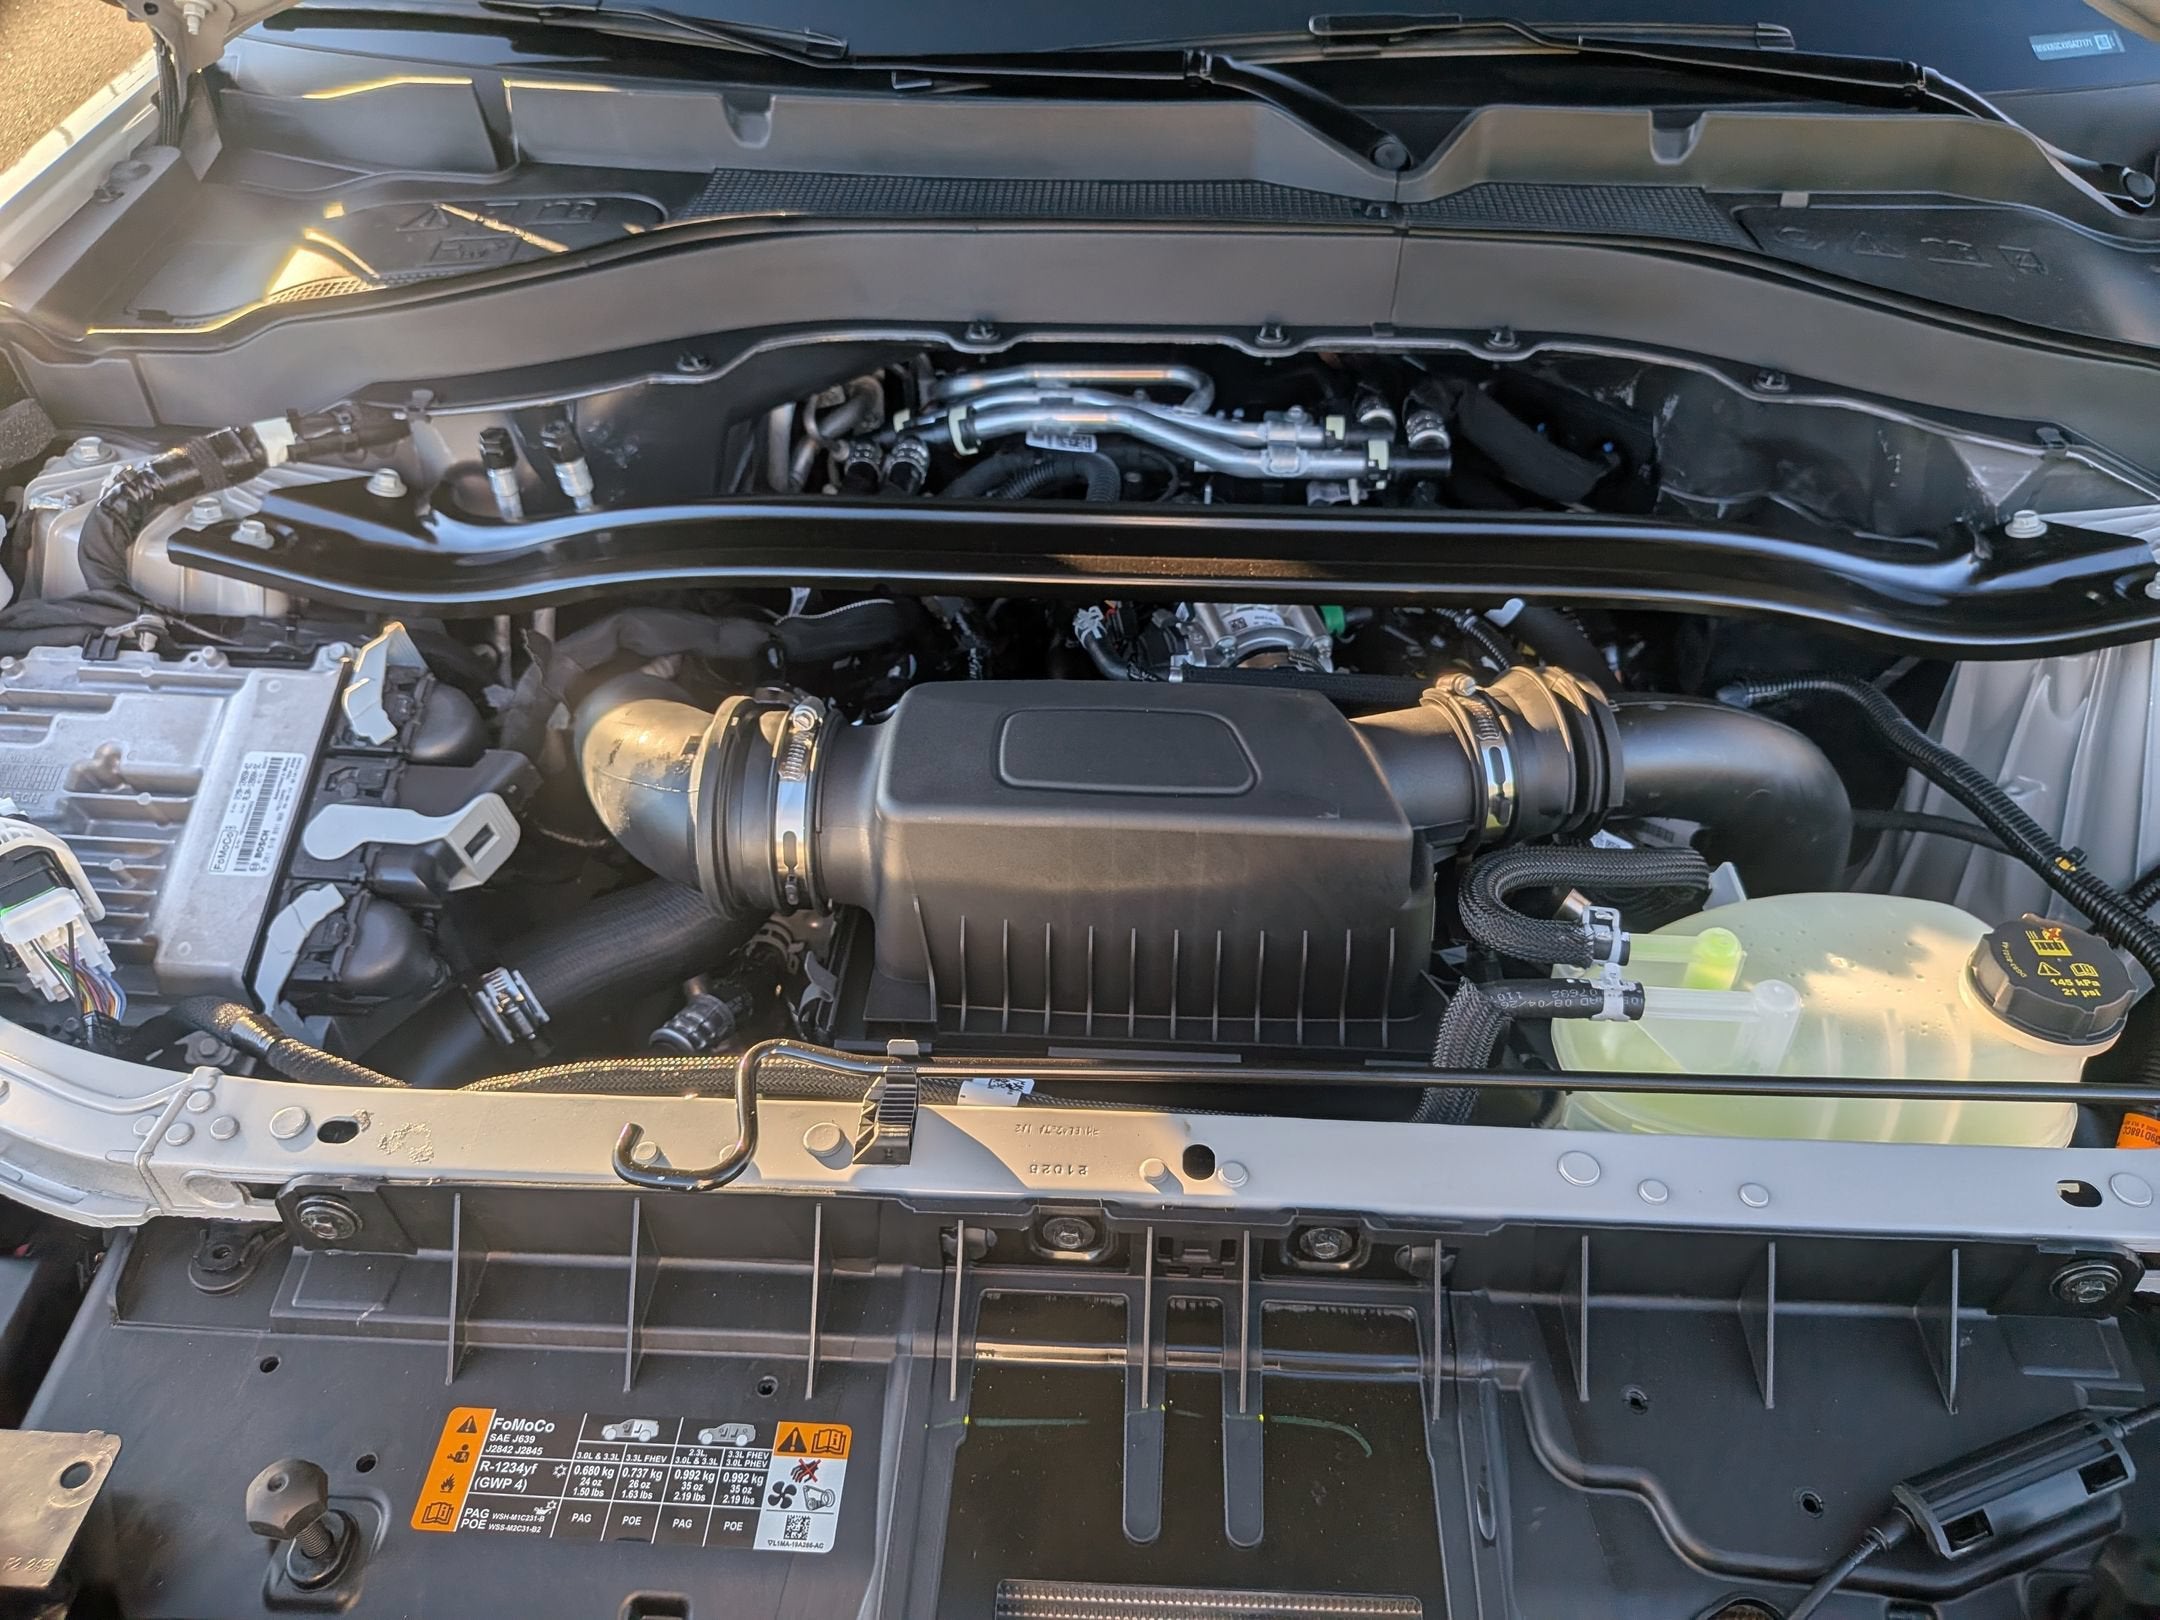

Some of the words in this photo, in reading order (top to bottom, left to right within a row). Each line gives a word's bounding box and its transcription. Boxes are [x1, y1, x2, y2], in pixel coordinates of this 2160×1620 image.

[254, 829, 270, 859] BOSCH
[213, 830, 234, 870] FoMoCo
[2050, 978, 2072, 987] 145
[2075, 978, 2101, 987] kPa
[2061, 987, 2078, 996] 21
[2080, 988, 2101, 998] psi
[492, 1417, 556, 1433] FoMoCo
[489, 1433, 511, 1443] SAE
[512, 1434, 536, 1445] J639
[485, 1444, 514, 1454] J2842
[514, 1445, 544, 1456] J2845
[727, 1450, 744, 1459] 3.3L
[745, 1451, 770, 1460] FHEV
[576, 1451, 593, 1460] 3.0L
[594, 1452, 602, 1460] &
[603, 1453, 620, 1461] 3.3L
[625, 1454, 642, 1462] 3.3L
[643, 1455, 667, 1463] FHEV
[675, 1456, 691, 1464] 3.0L
[693, 1457, 700, 1465] &
[701, 1457, 718, 1466] 3.3L
[479, 1460, 538, 1477] R-1234yf
[725, 1459, 742, 1467] 3.0L
[743, 1460, 768, 1468] PHEV
[573, 1465, 601, 1476] 0.680
[601, 1466, 615, 1480] kg
[622, 1467, 649, 1478] 0.737
[649, 1468, 663, 1482] kg
[674, 1469, 701, 1480] 0.992
[702, 1470, 716, 1484] kg
[474, 1476, 513, 1490] (GWP
[514, 1479, 528, 1493] 4)
[579, 1477, 591, 1486] 24
[591, 1479, 603, 1487] oz
[628, 1479, 639, 1489] 26
[640, 1481, 652, 1489] oz
[723, 1472, 750, 1484] 0.992
[750, 1473, 764, 1487] kg
[681, 1481, 692, 1490] 35
[693, 1483, 704, 1491] oz
[730, 1484, 741, 1494] 35
[741, 1486, 753, 1495] oz
[573, 1487, 590, 1496] 1.50
[590, 1487, 605, 1498] lbs
[621, 1490, 638, 1499] 1.63
[639, 1490, 653, 1500] lbs
[673, 1491, 692, 1501] 2.19
[692, 1492, 706, 1502] lbs
[722, 1494, 741, 1504] 2.19
[741, 1495, 755, 1505] lbs
[463, 1507, 490, 1519] PAG
[571, 1513, 592, 1523] PAG
[460, 1518, 487, 1530] POE
[622, 1516, 642, 1526] POE
[672, 1518, 693, 1528] PAG
[723, 1521, 744, 1531] POE
